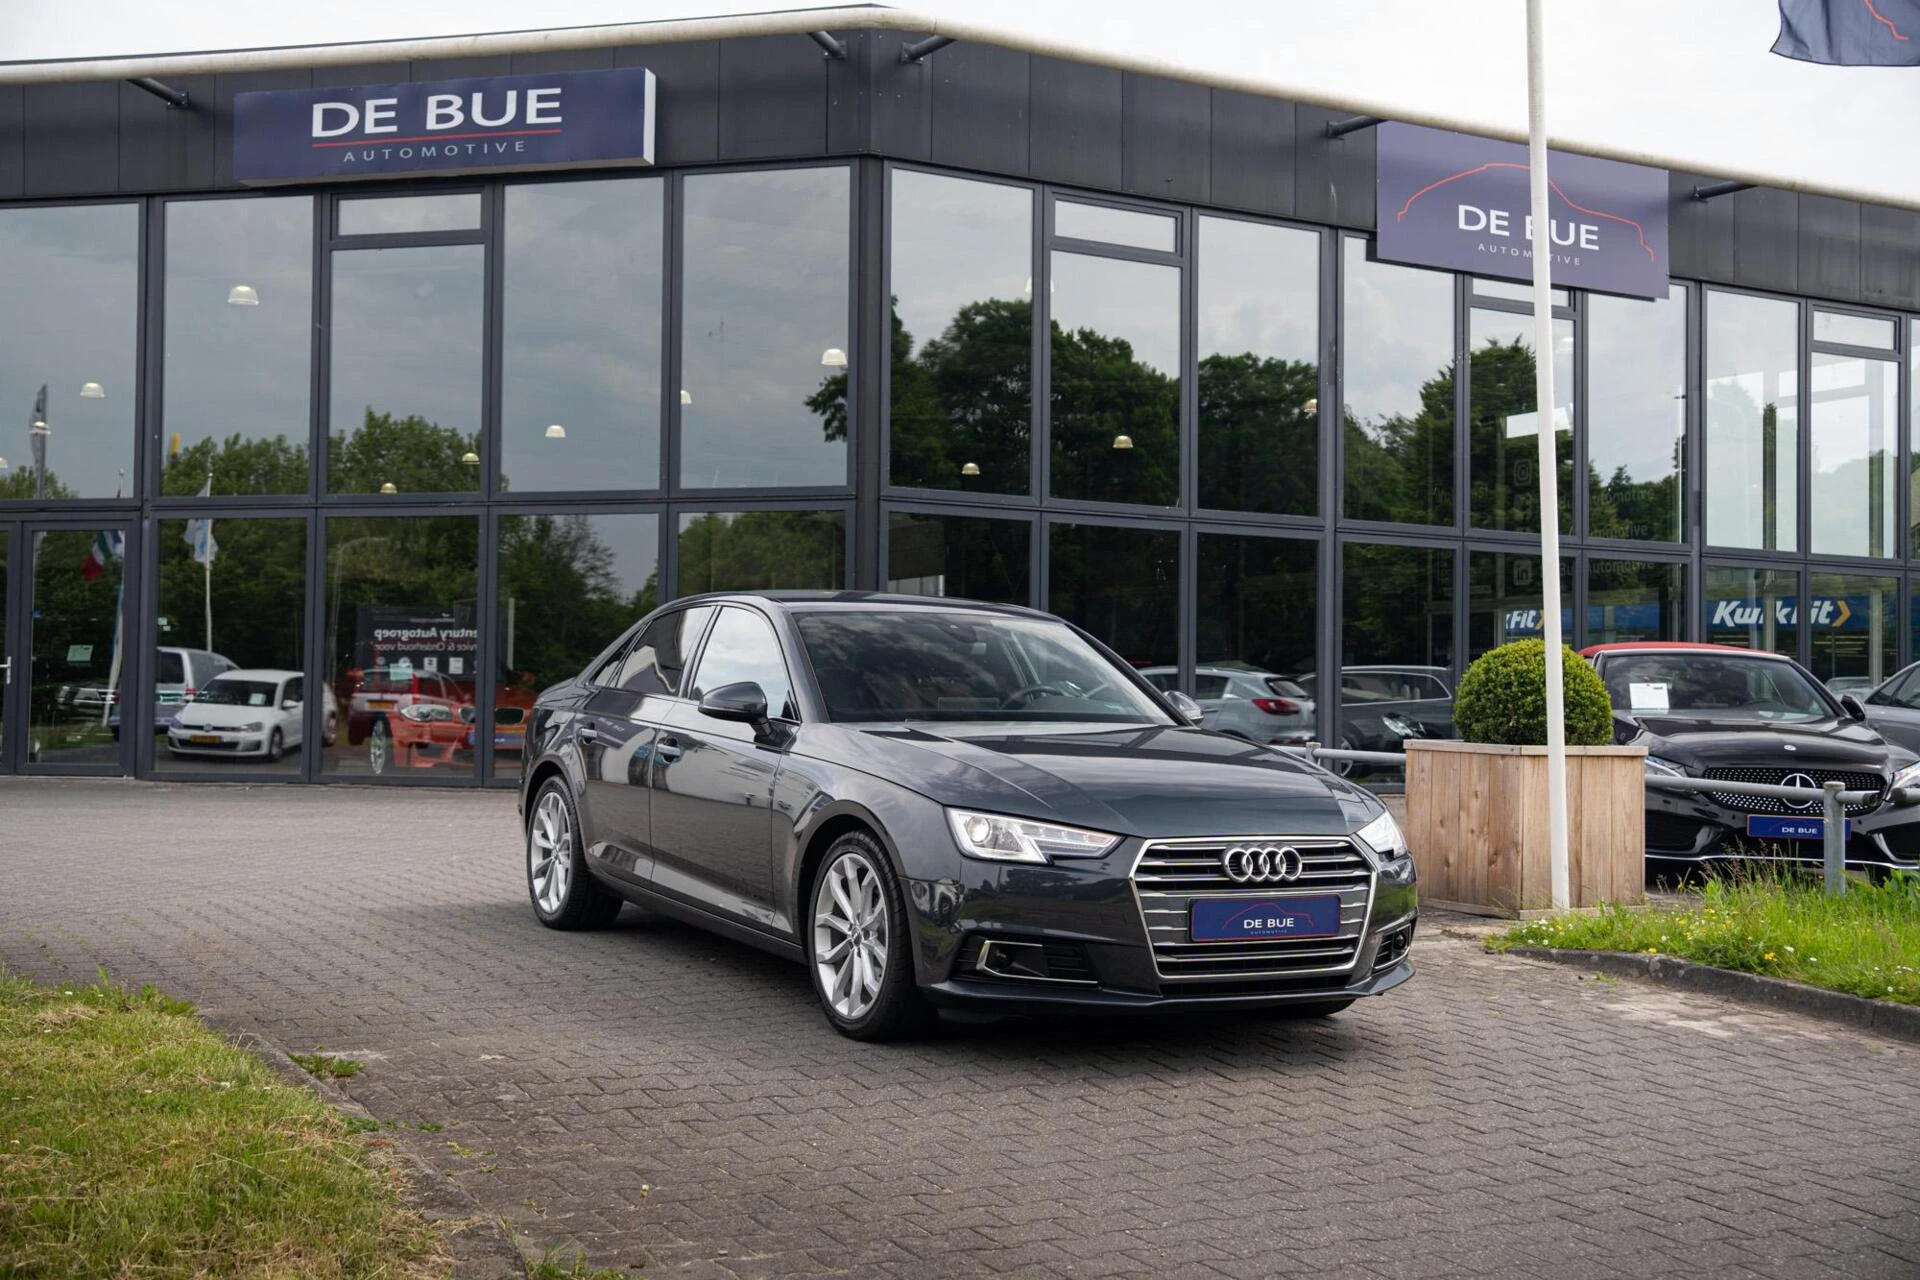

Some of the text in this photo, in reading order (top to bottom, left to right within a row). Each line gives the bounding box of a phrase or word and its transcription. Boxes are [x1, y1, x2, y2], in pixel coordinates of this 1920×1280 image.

[312, 87, 562, 138] DE BUE
[343, 141, 525, 162] AUTOMOTIVE
[1458, 204, 1510, 237] DE
[1478, 243, 1581, 265] AUTOMTIVE
[1790, 600, 1834, 625] it
[1243, 918, 1295, 929] DE BUE
